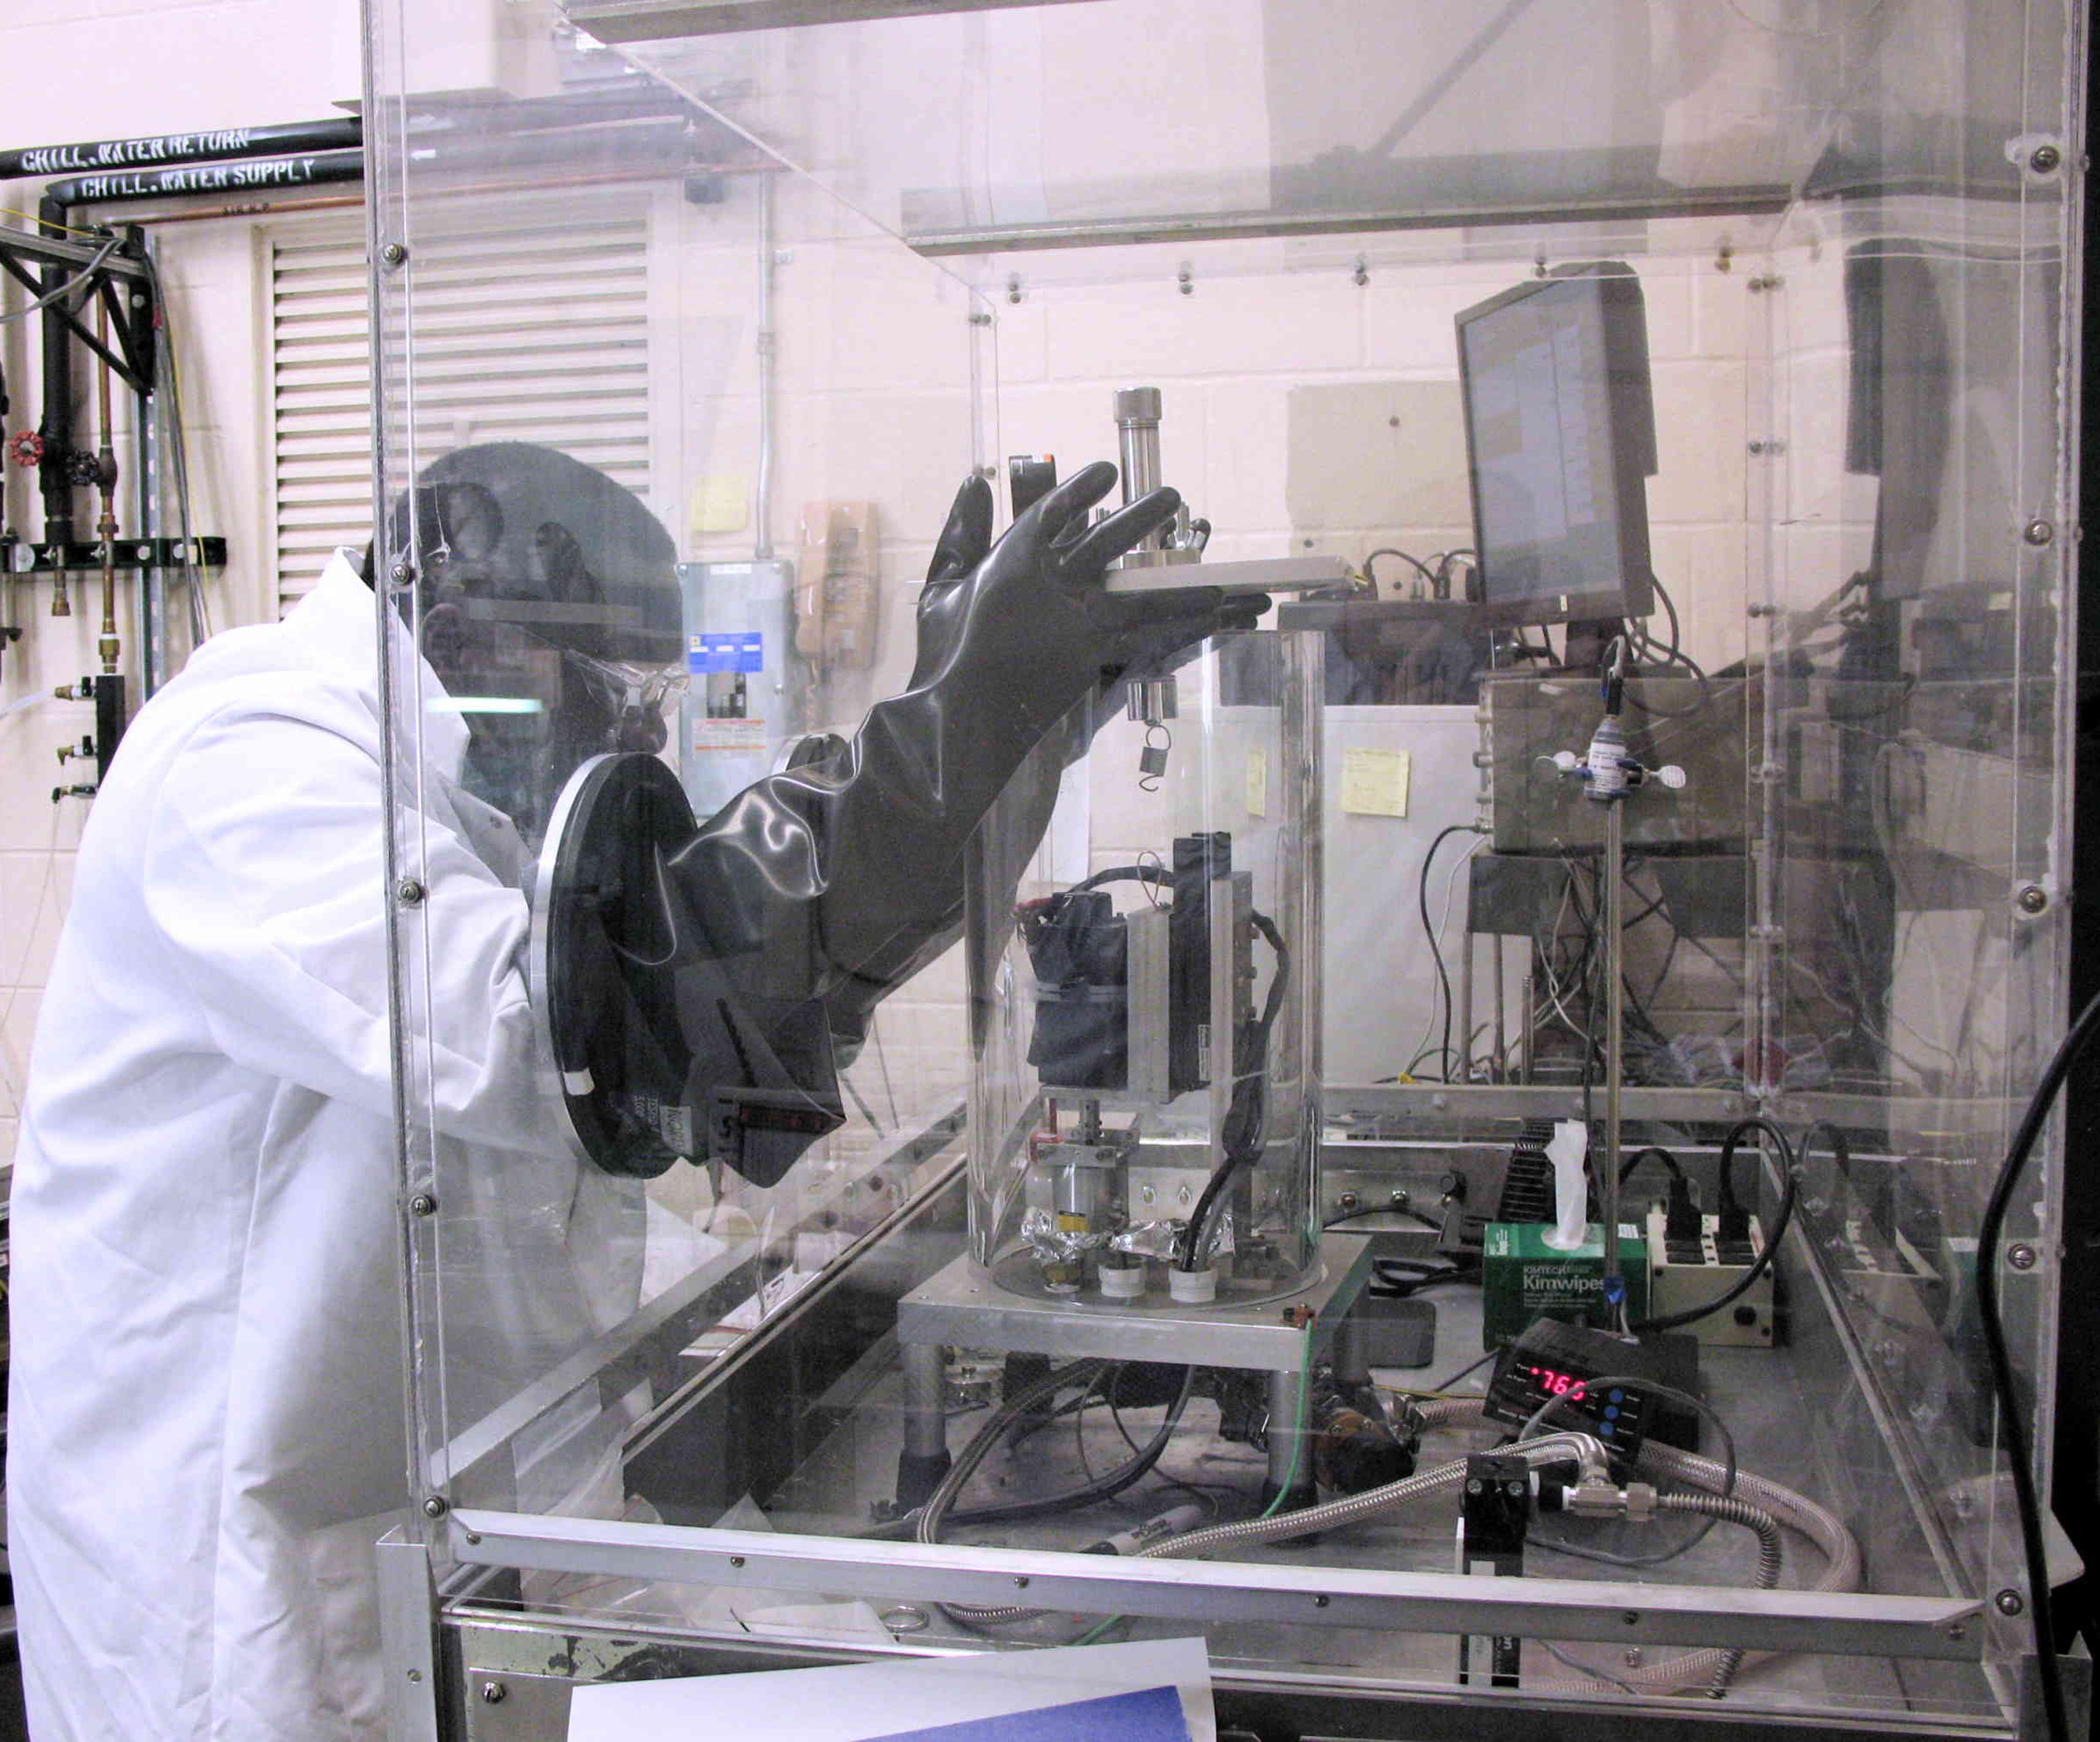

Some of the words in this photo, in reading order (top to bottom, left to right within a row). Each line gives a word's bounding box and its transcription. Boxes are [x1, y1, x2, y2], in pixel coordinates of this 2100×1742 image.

[98, 138, 167, 164] WATER
[168, 129, 250, 155] RETURN
[160, 166, 227, 190] WATER
[232, 158, 315, 185] SUPPLY
